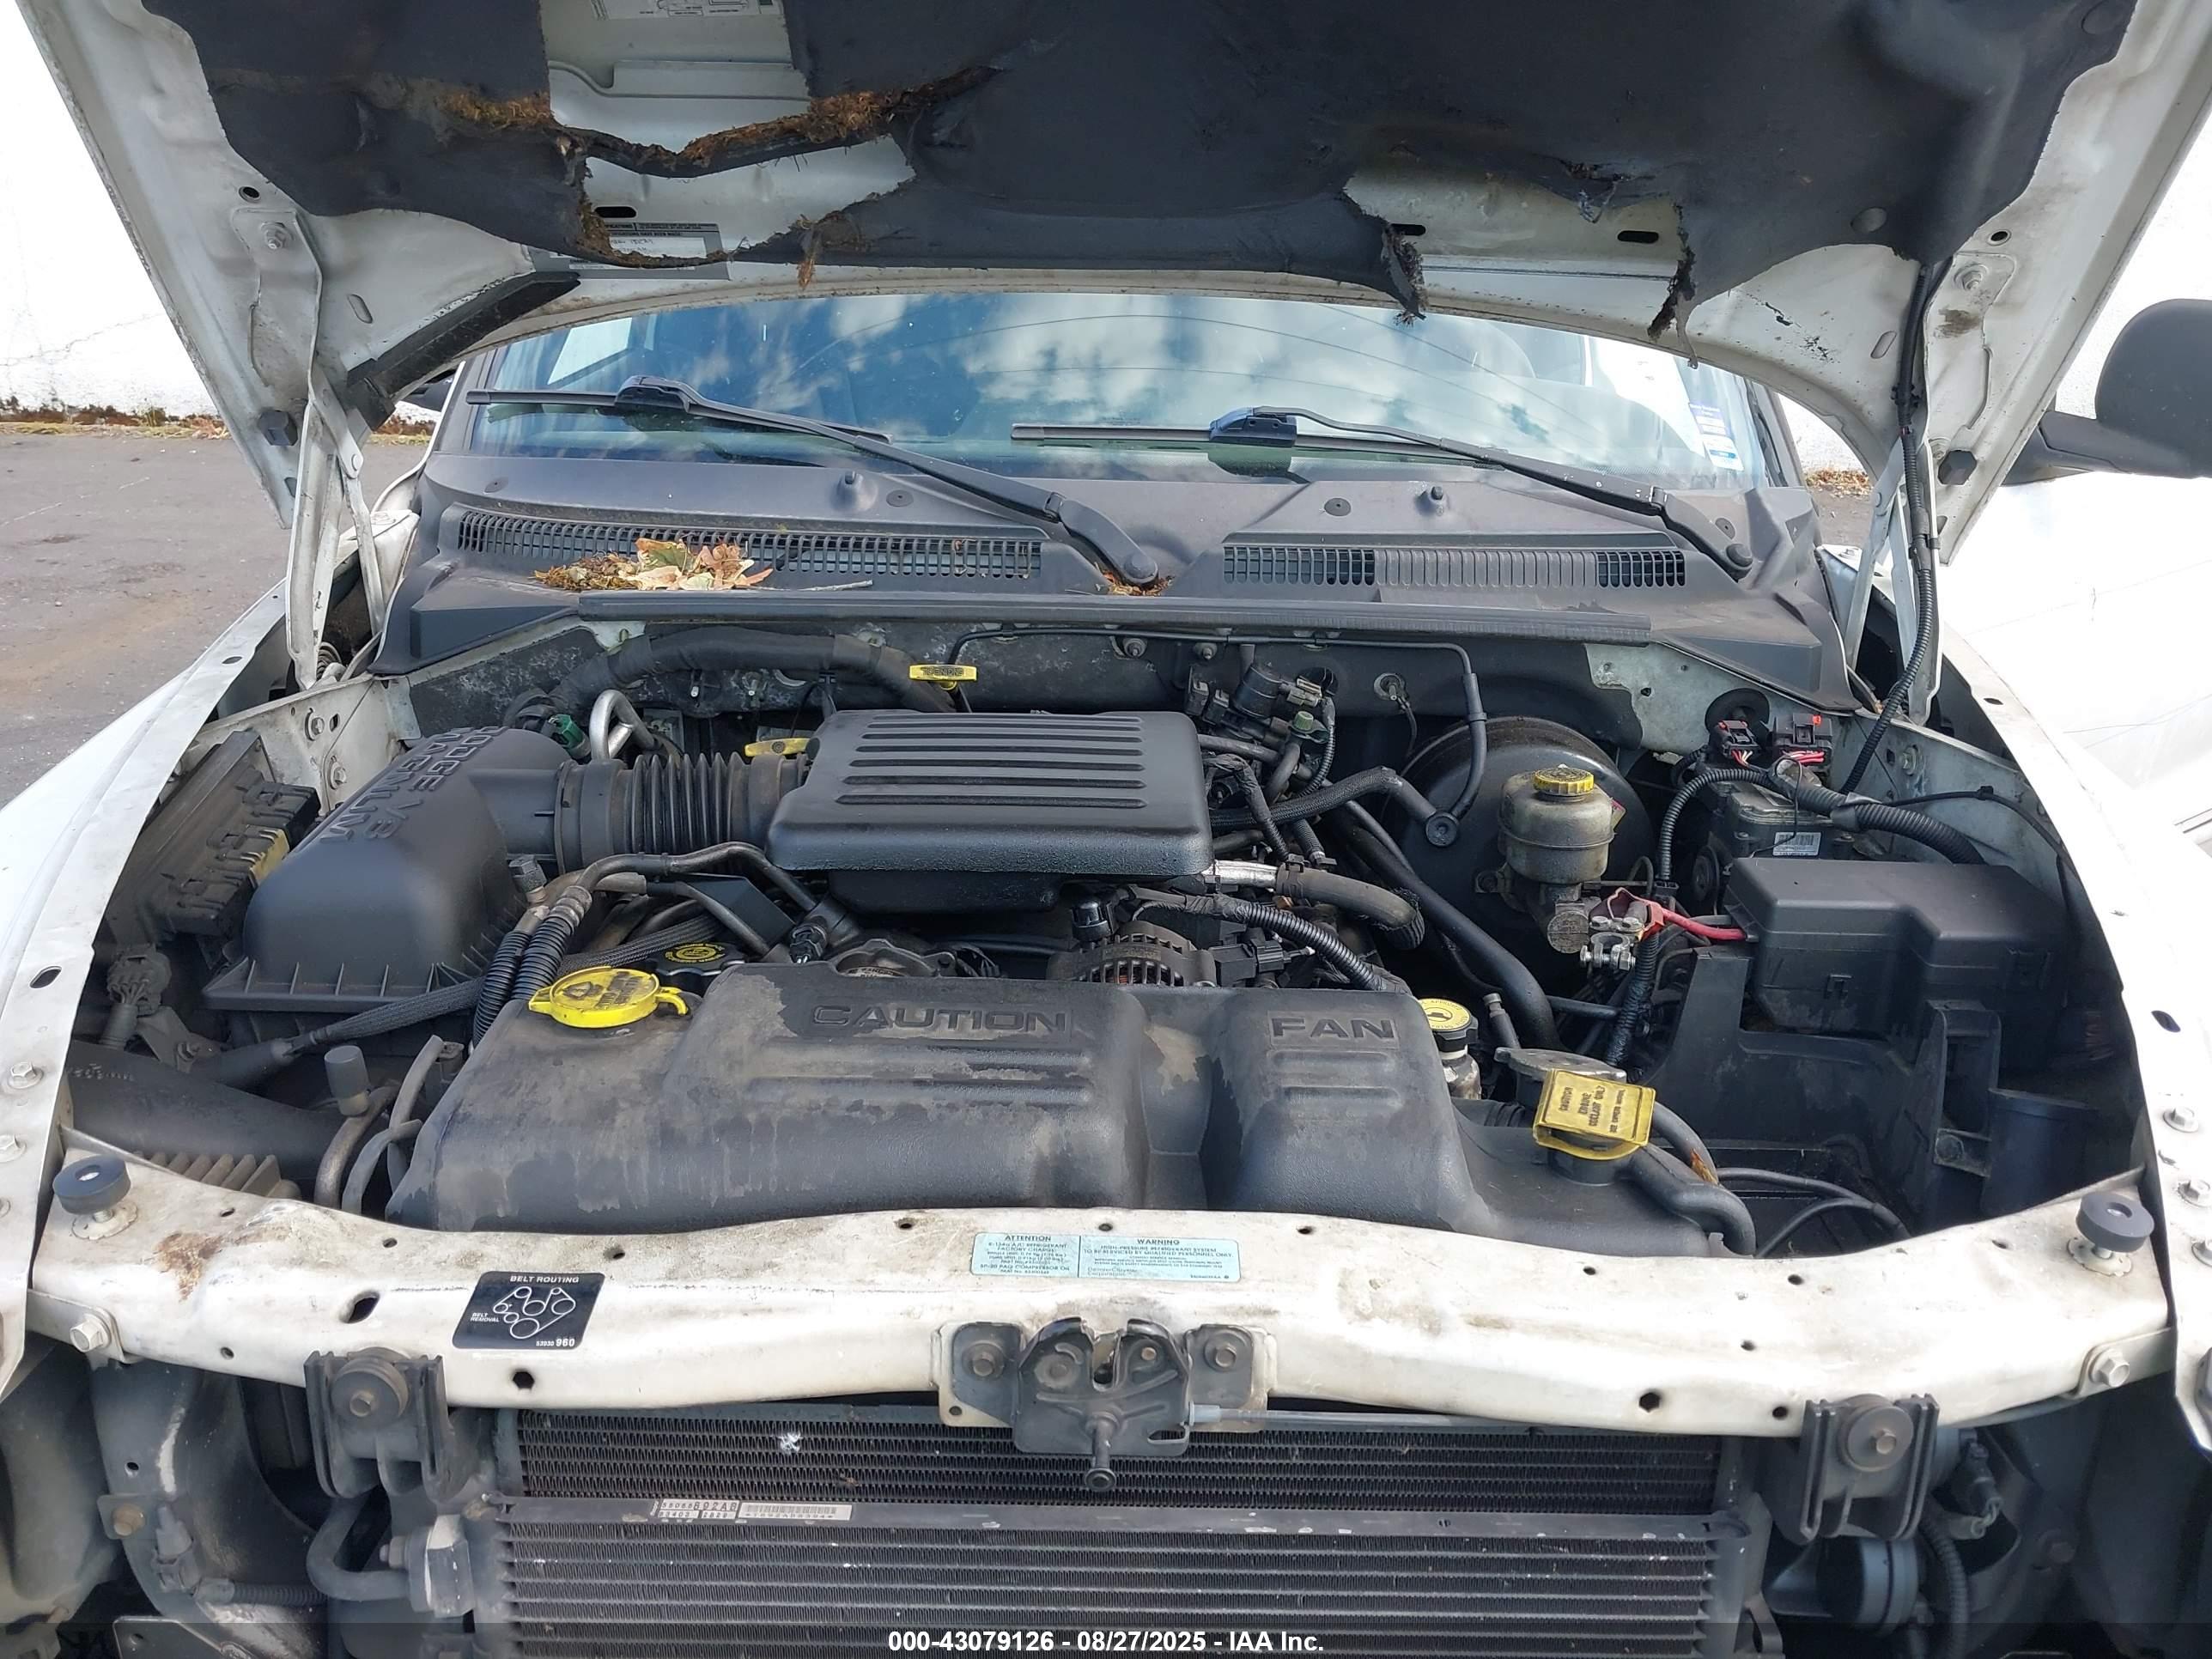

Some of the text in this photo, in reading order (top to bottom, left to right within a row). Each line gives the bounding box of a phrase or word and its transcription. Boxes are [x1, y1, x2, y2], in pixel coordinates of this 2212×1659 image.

[408, 726, 509, 793] DODGE
[811, 1005, 1395, 1041] CAUTION FAN
[556, 1339, 575, 1347] 960
